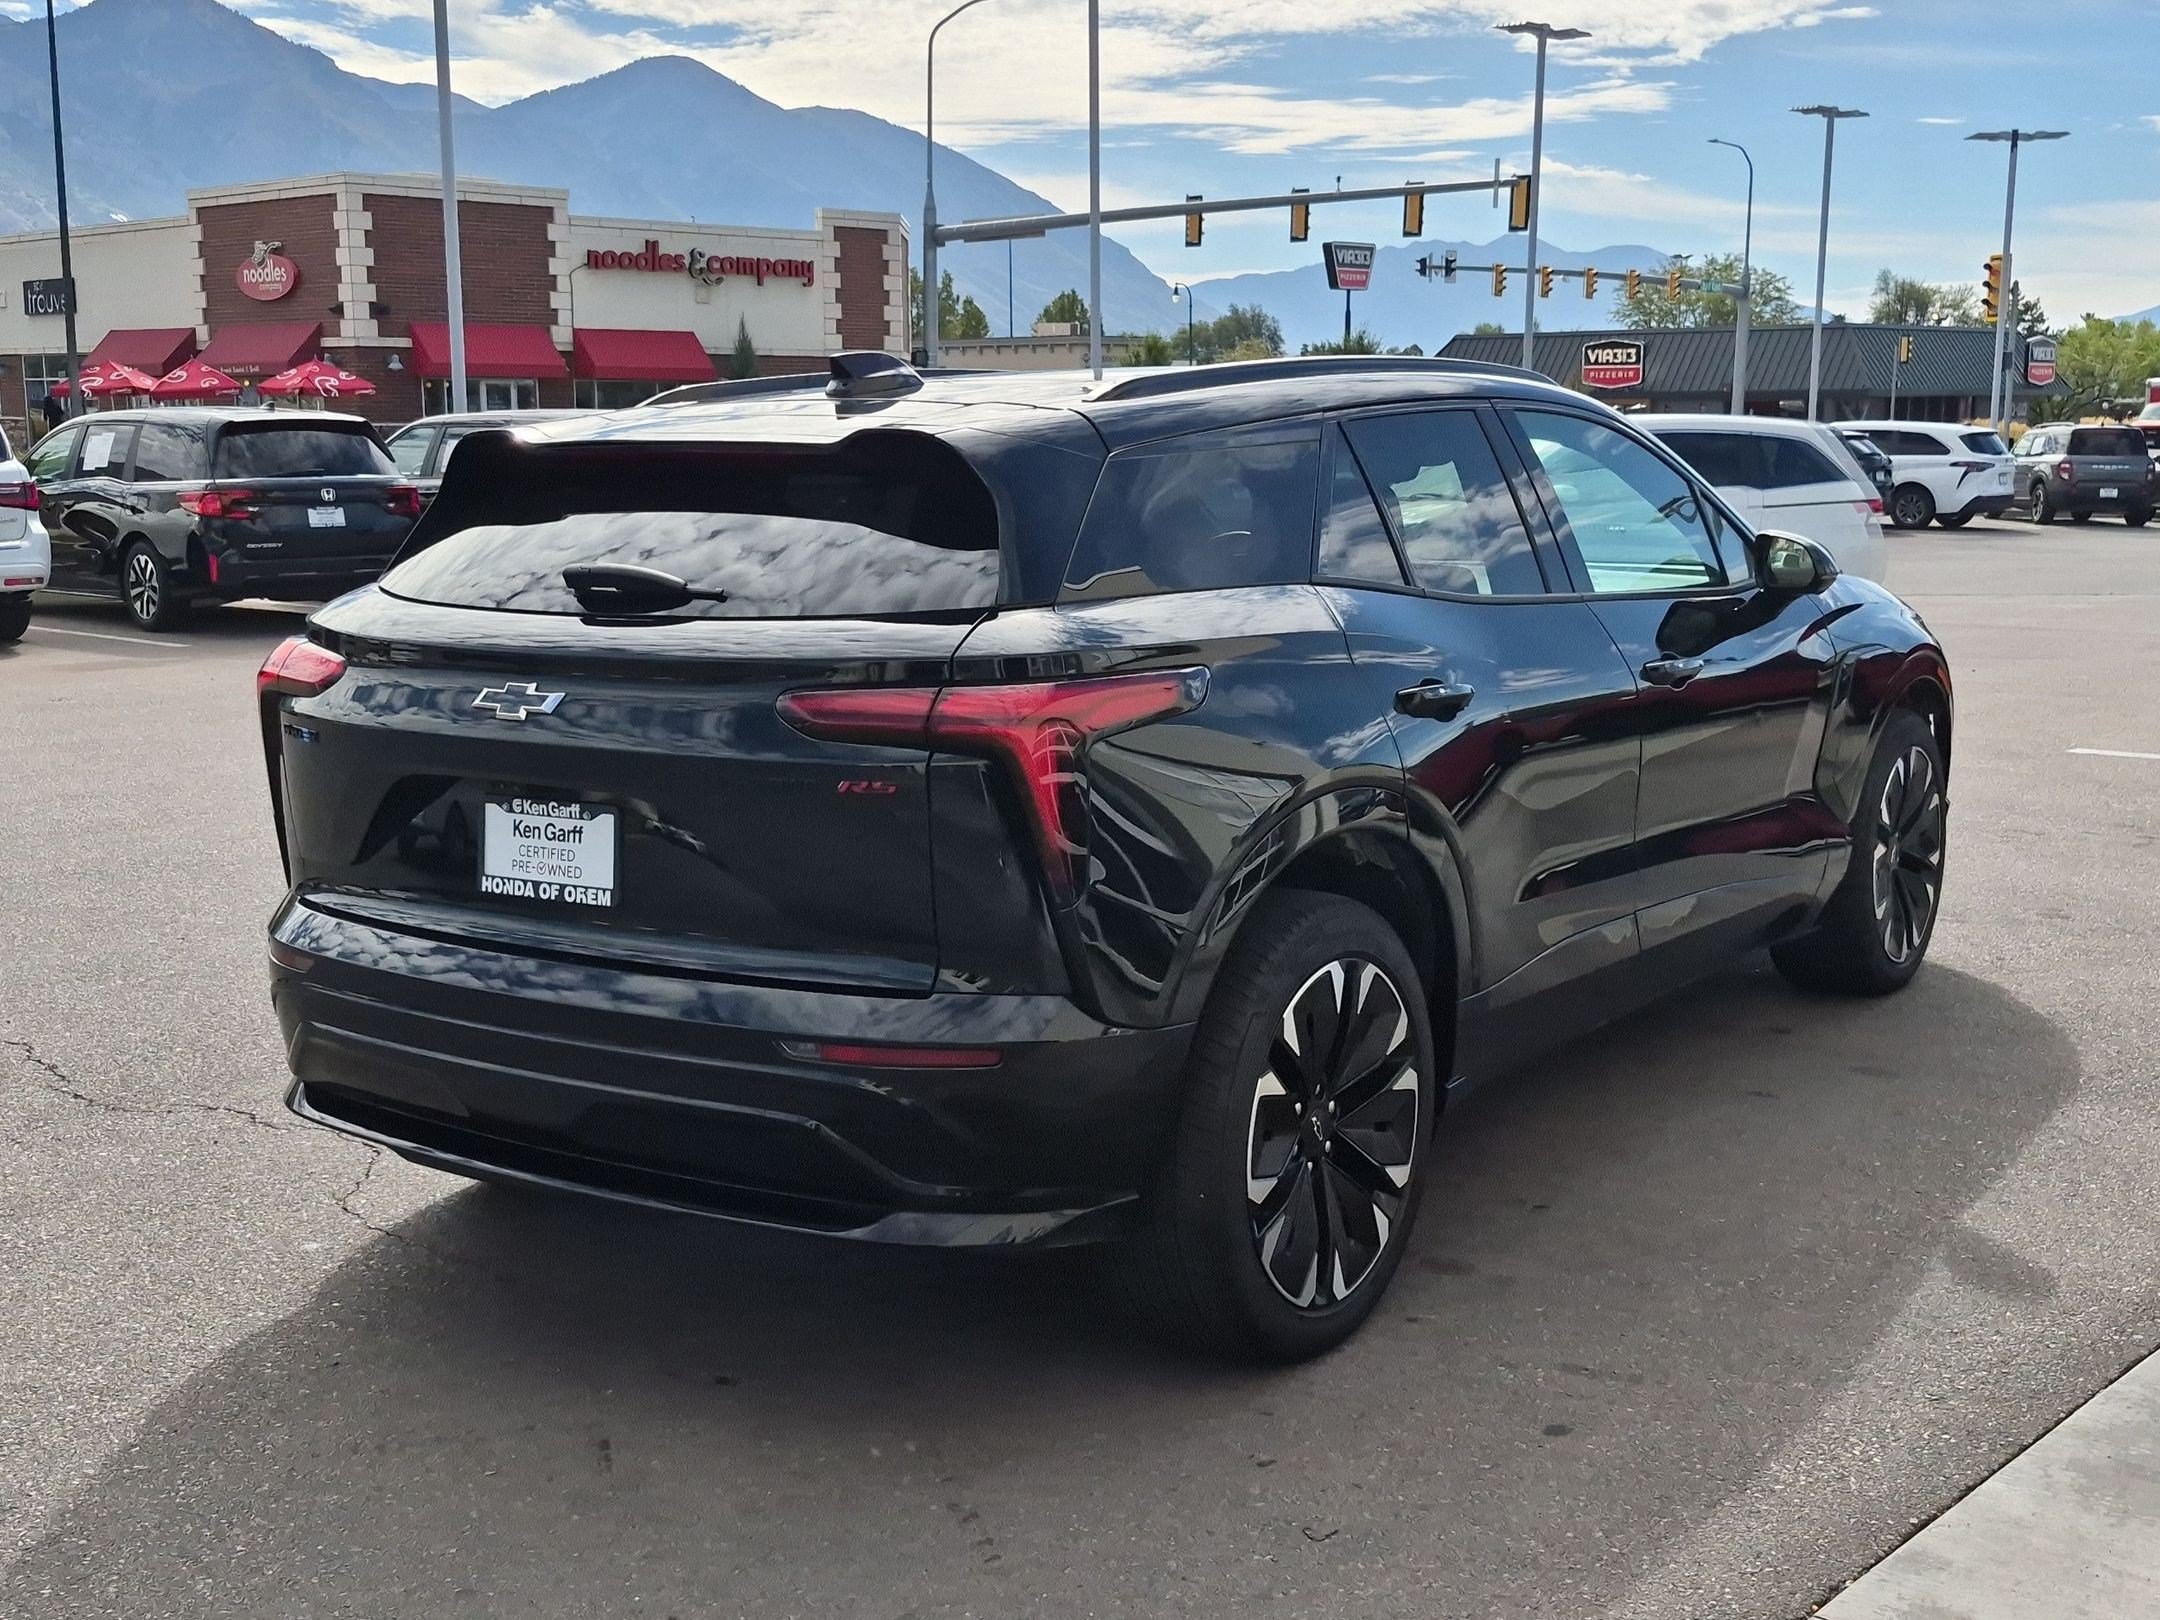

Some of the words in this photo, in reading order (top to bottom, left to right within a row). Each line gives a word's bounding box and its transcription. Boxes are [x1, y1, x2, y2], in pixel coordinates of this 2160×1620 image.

[243, 258, 287, 284] noodles
[586, 239, 687, 273] noodles
[706, 255, 814, 287] company
[1587, 348, 1636, 363] VIA313
[1589, 370, 1634, 379] PIZZERIA
[837, 780, 896, 794] RS
[523, 799, 547, 816] Ken
[548, 801, 581, 819] Garff
[513, 819, 541, 840] Ken
[544, 822, 584, 844] Garff
[518, 844, 576, 862] CERTIFIED
[511, 859, 582, 879] PRE-OWNED
[481, 876, 535, 899] HONDA
[538, 882, 560, 900] OF
[563, 886, 612, 907] OREM
